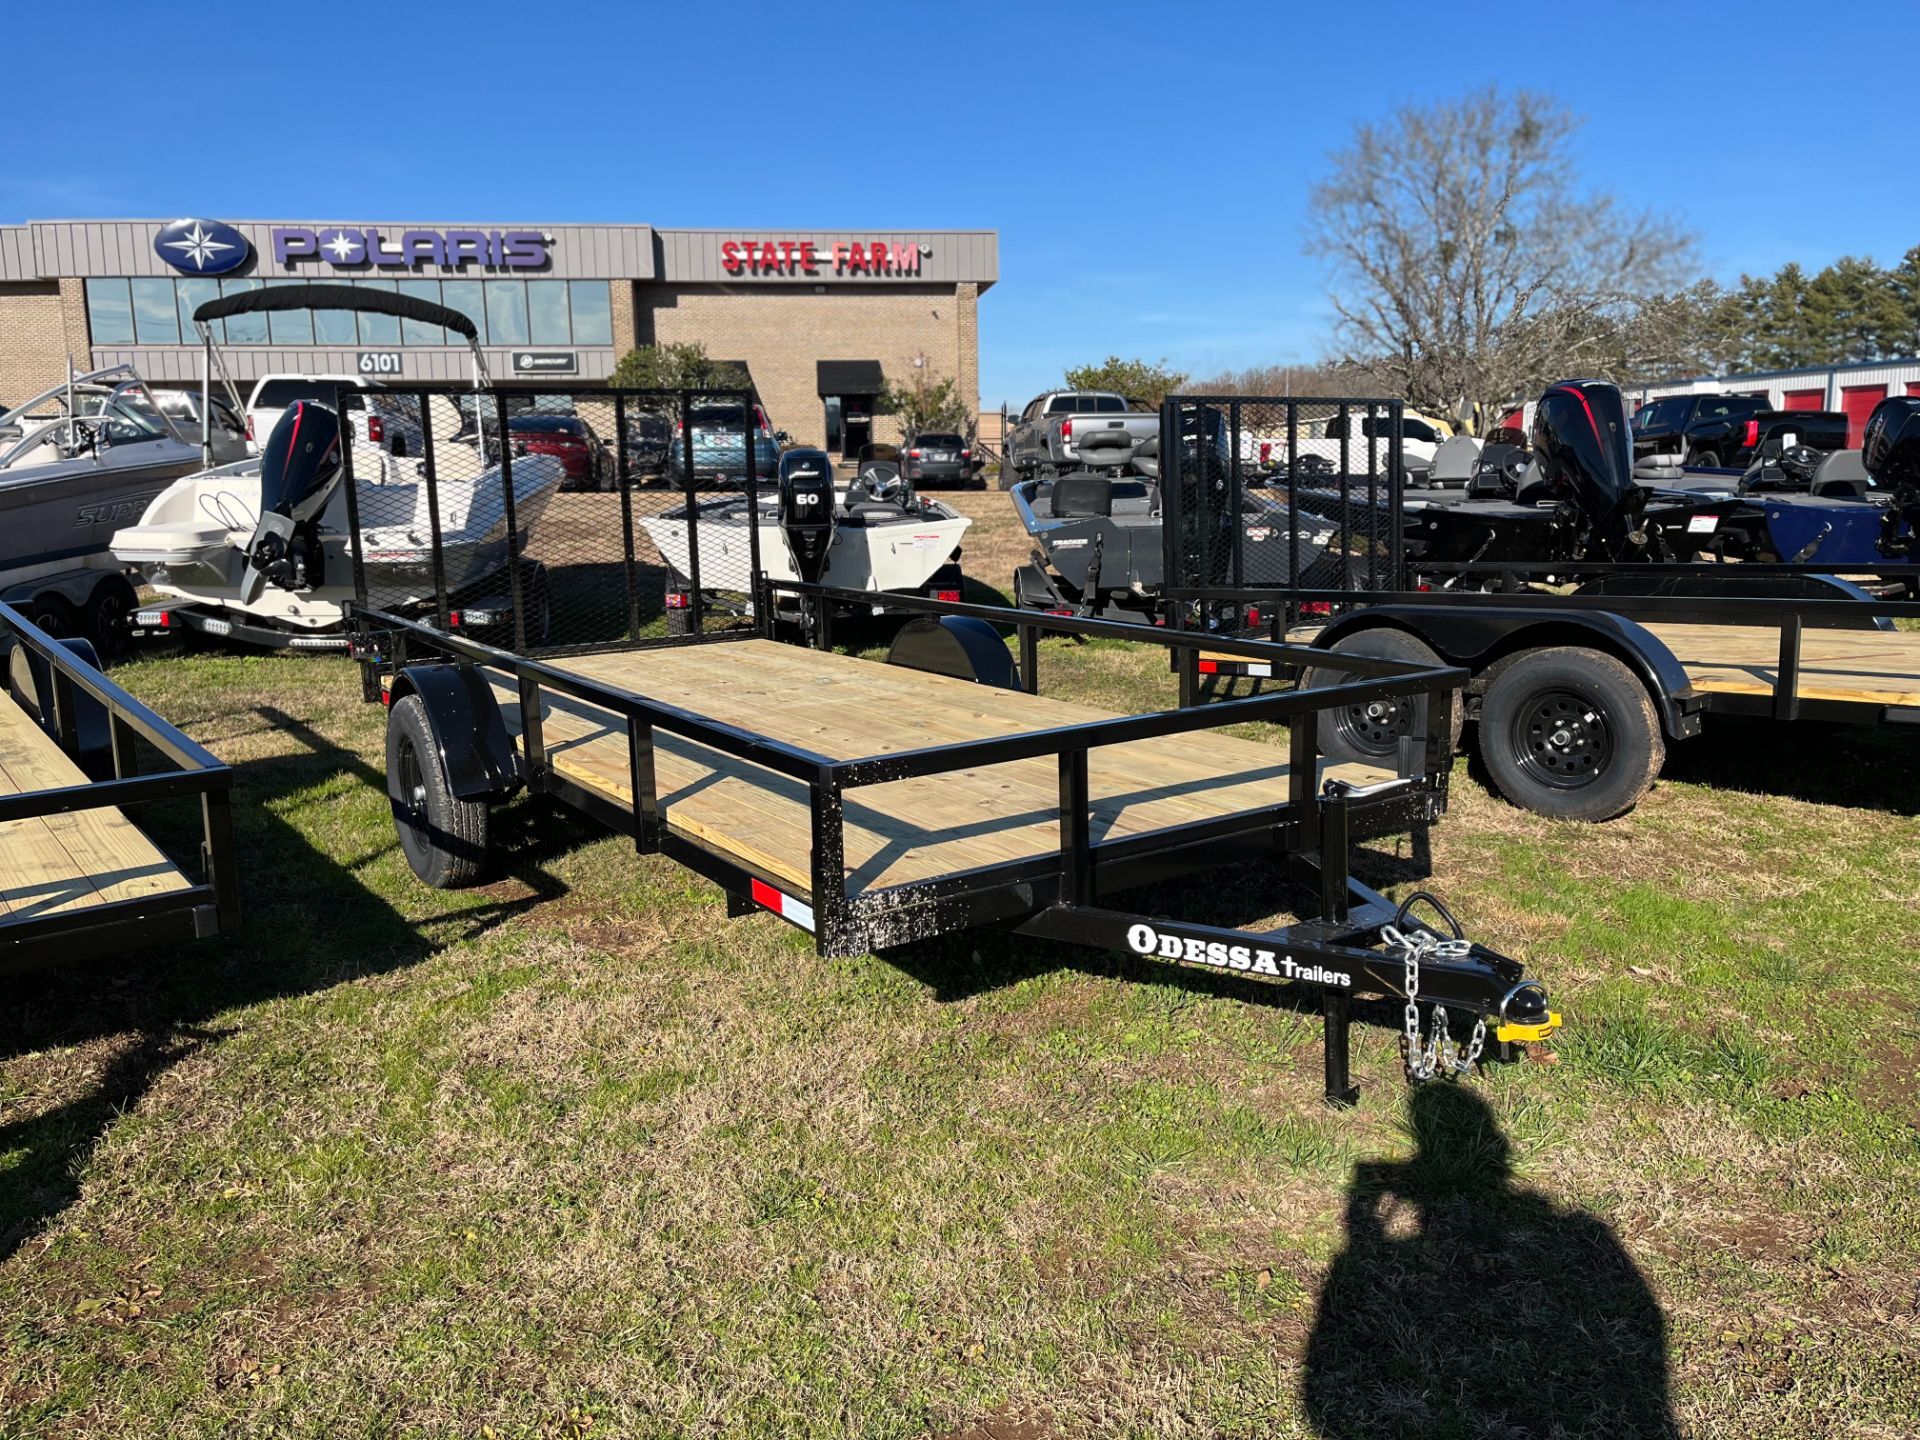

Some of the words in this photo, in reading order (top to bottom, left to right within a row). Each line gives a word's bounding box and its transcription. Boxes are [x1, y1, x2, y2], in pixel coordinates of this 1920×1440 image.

[272, 228, 548, 266] POLARIS
[721, 241, 816, 270] STATE
[360, 353, 400, 372] 6101
[796, 493, 819, 505] 60
[1051, 538, 1089, 546] TRACKER
[1127, 924, 1280, 975] ODESSA
[1281, 956, 1351, 986] trailers
